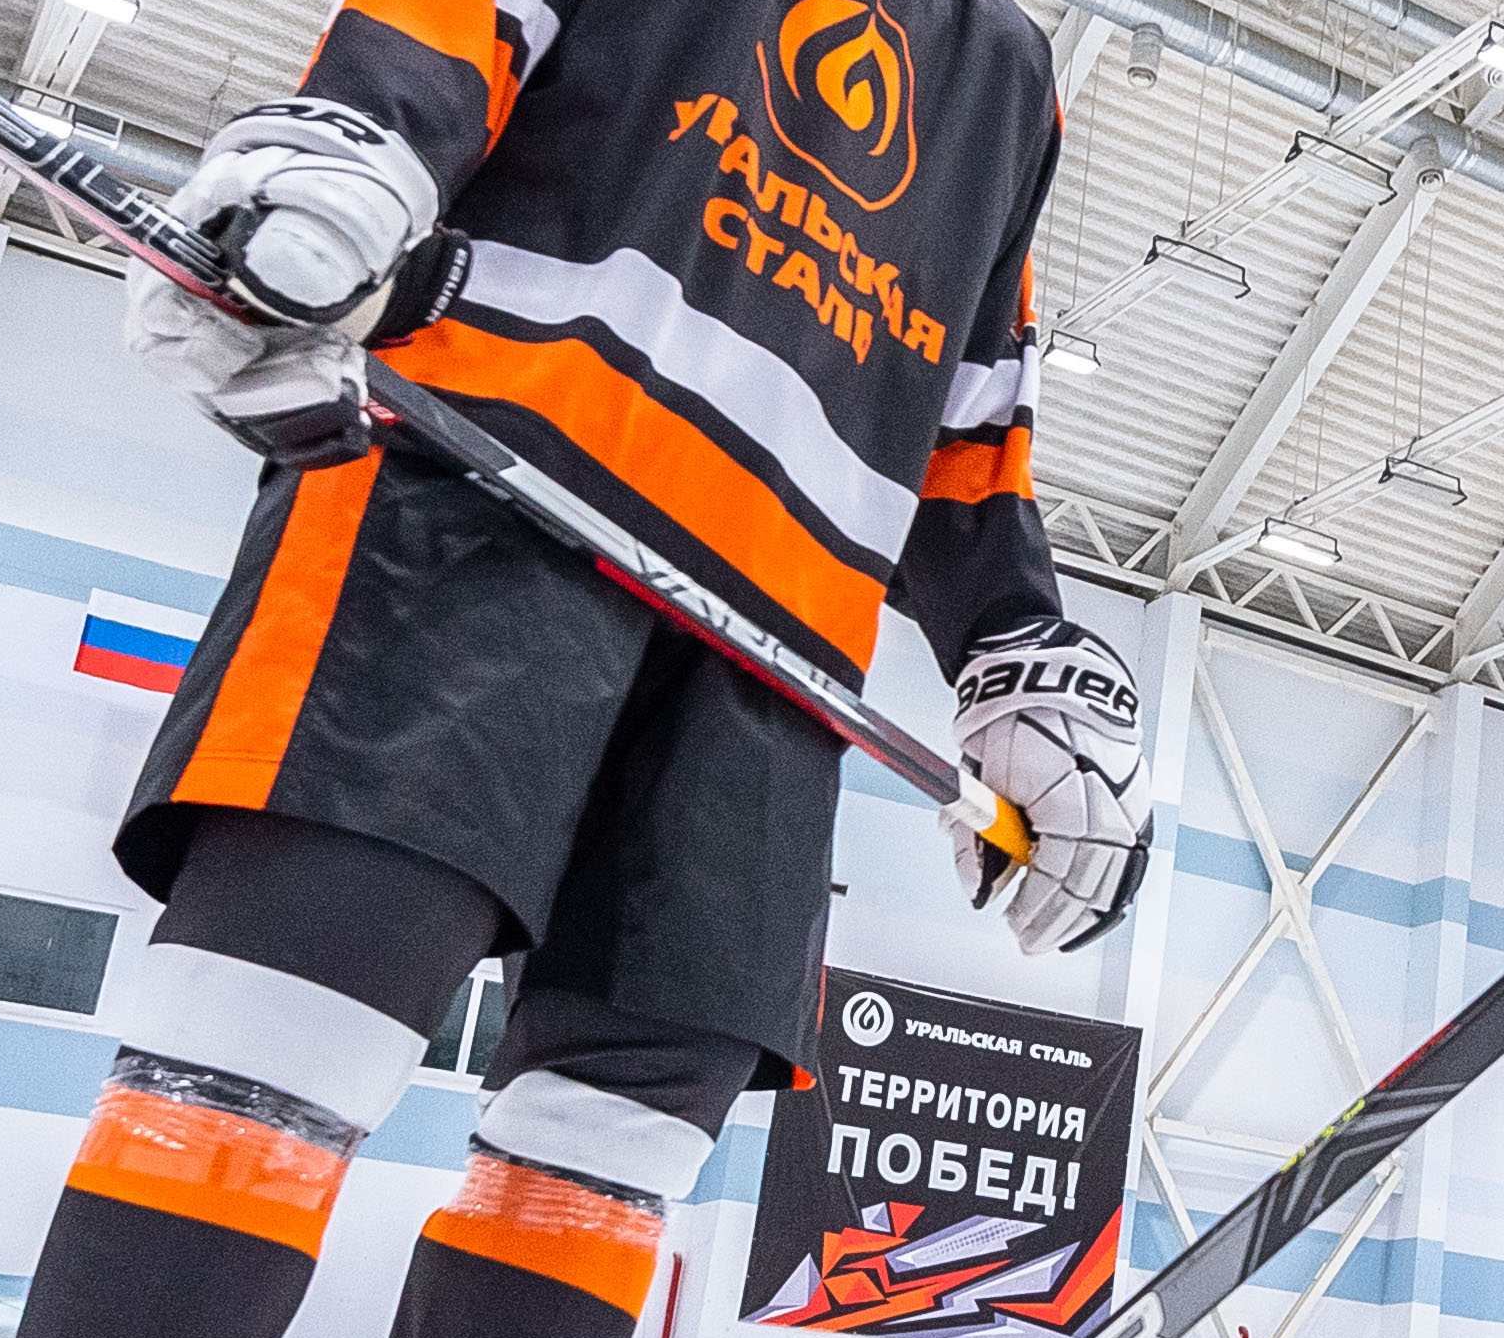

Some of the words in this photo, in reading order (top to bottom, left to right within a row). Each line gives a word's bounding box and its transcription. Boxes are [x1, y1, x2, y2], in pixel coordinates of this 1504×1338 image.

[954, 660, 1139, 722] BAUER
[905, 1018, 1022, 1056] УРАЛЬСКАЯ
[1029, 1043, 1093, 1069] СТАЛЬ
[838, 1065, 1087, 1143] ТЕРРИТОРИЯ
[826, 1123, 1081, 1217] ПОБЕД!
